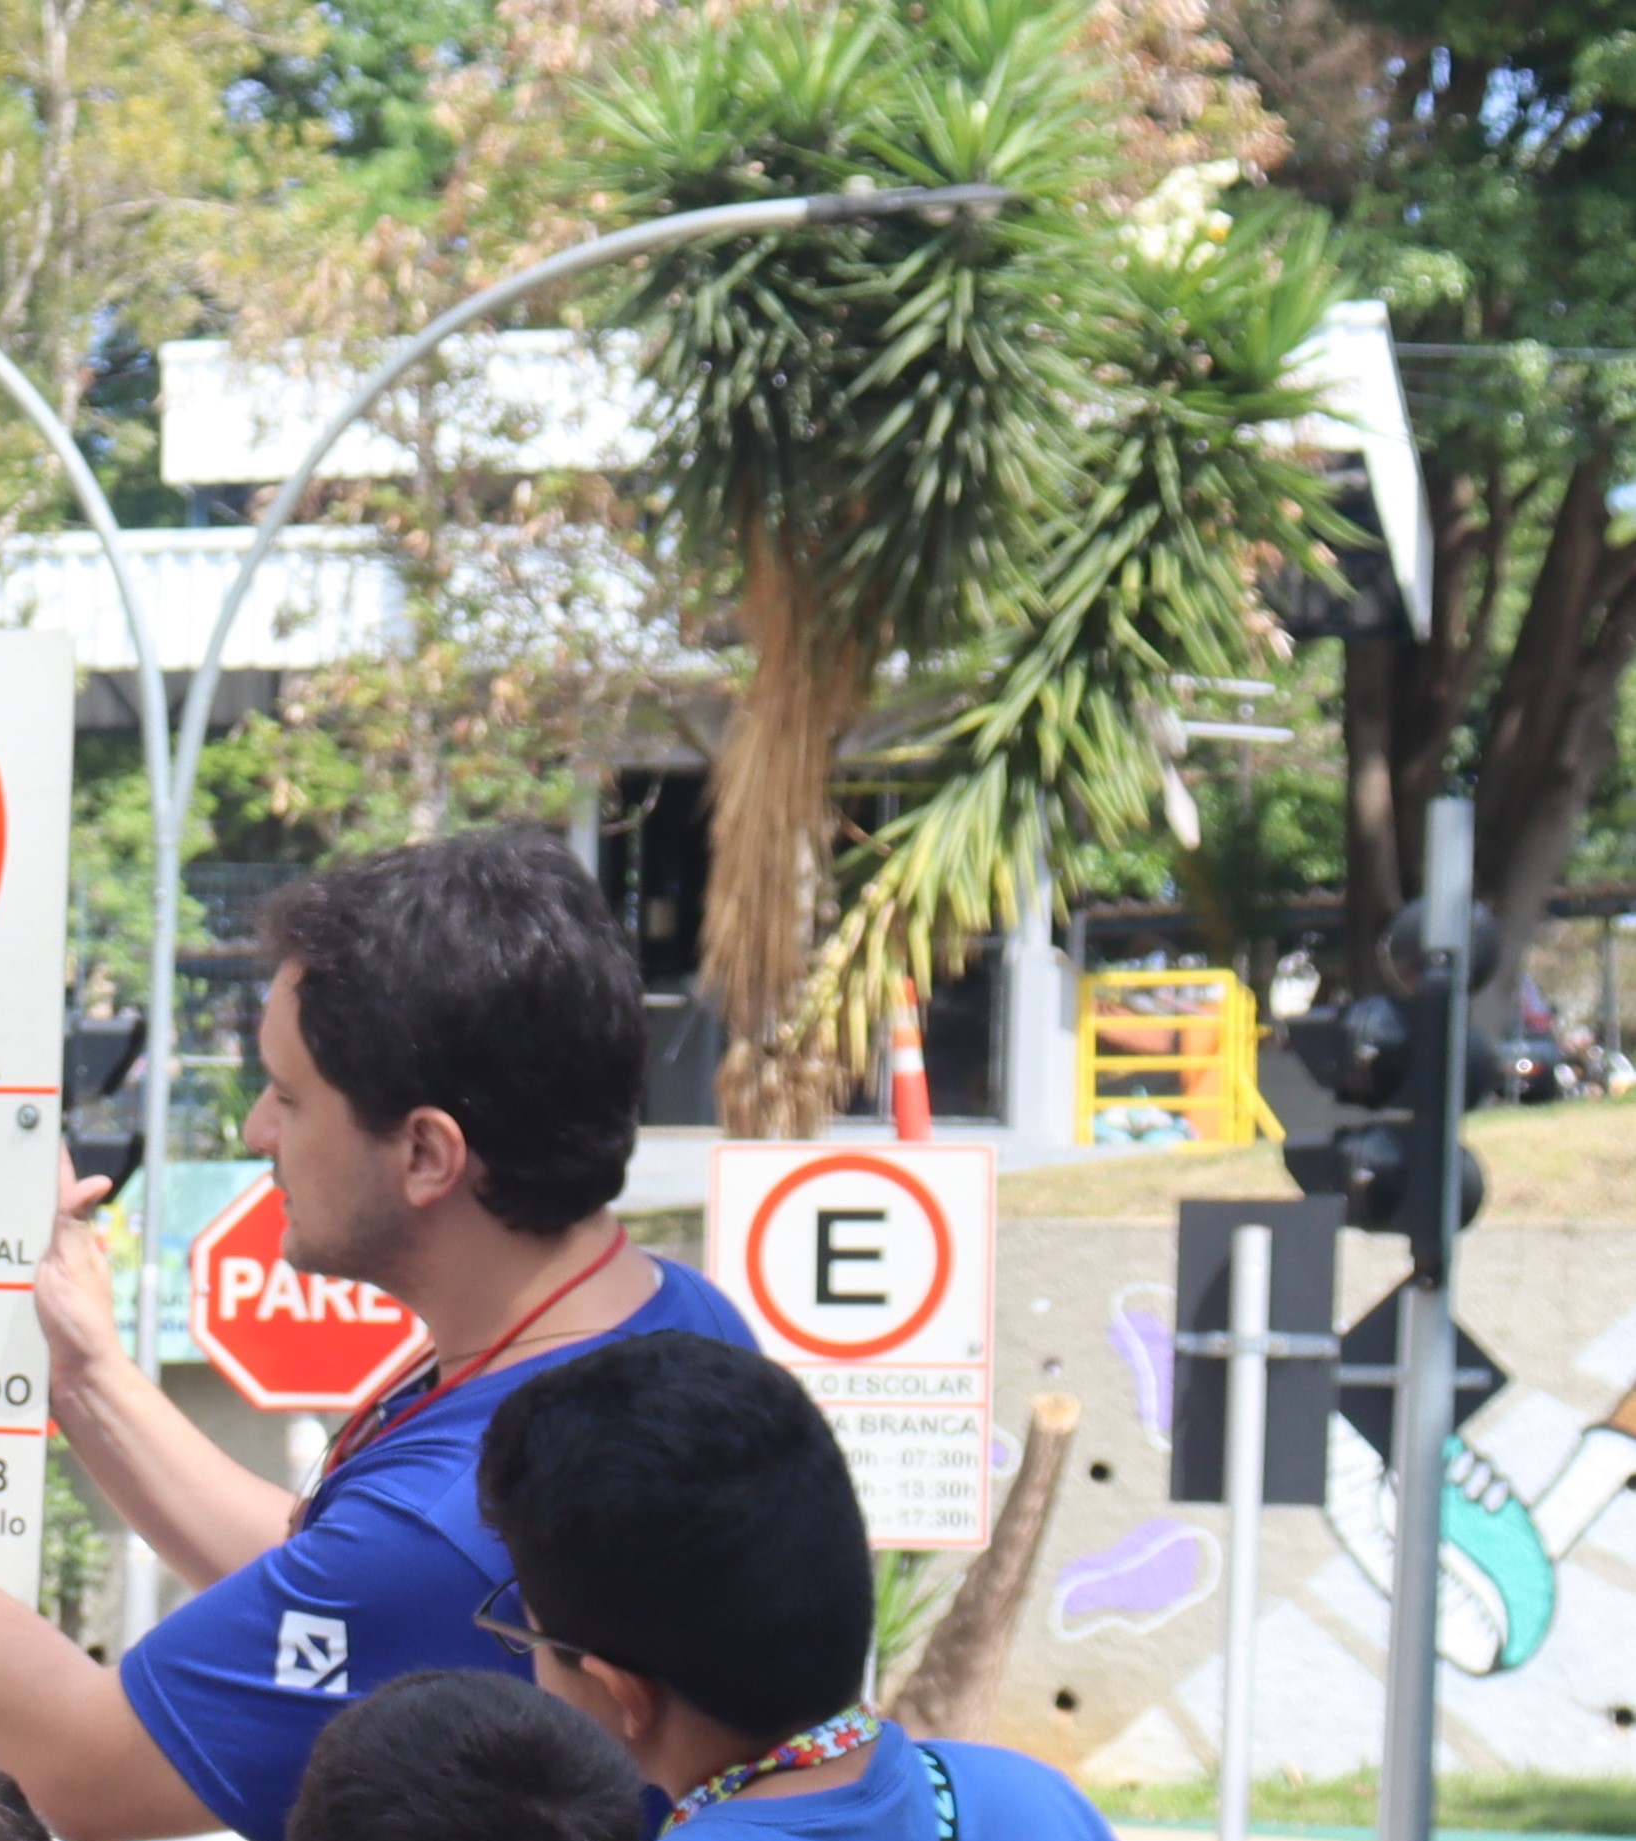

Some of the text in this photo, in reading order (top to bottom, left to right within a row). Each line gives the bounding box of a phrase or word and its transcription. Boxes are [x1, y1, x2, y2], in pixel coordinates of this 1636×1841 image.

[816, 1210, 888, 1306] E
[219, 1257, 402, 1322] PARE
[848, 1374, 974, 1395] ESCOLAR
[860, 1414, 979, 1435] BRANCA
